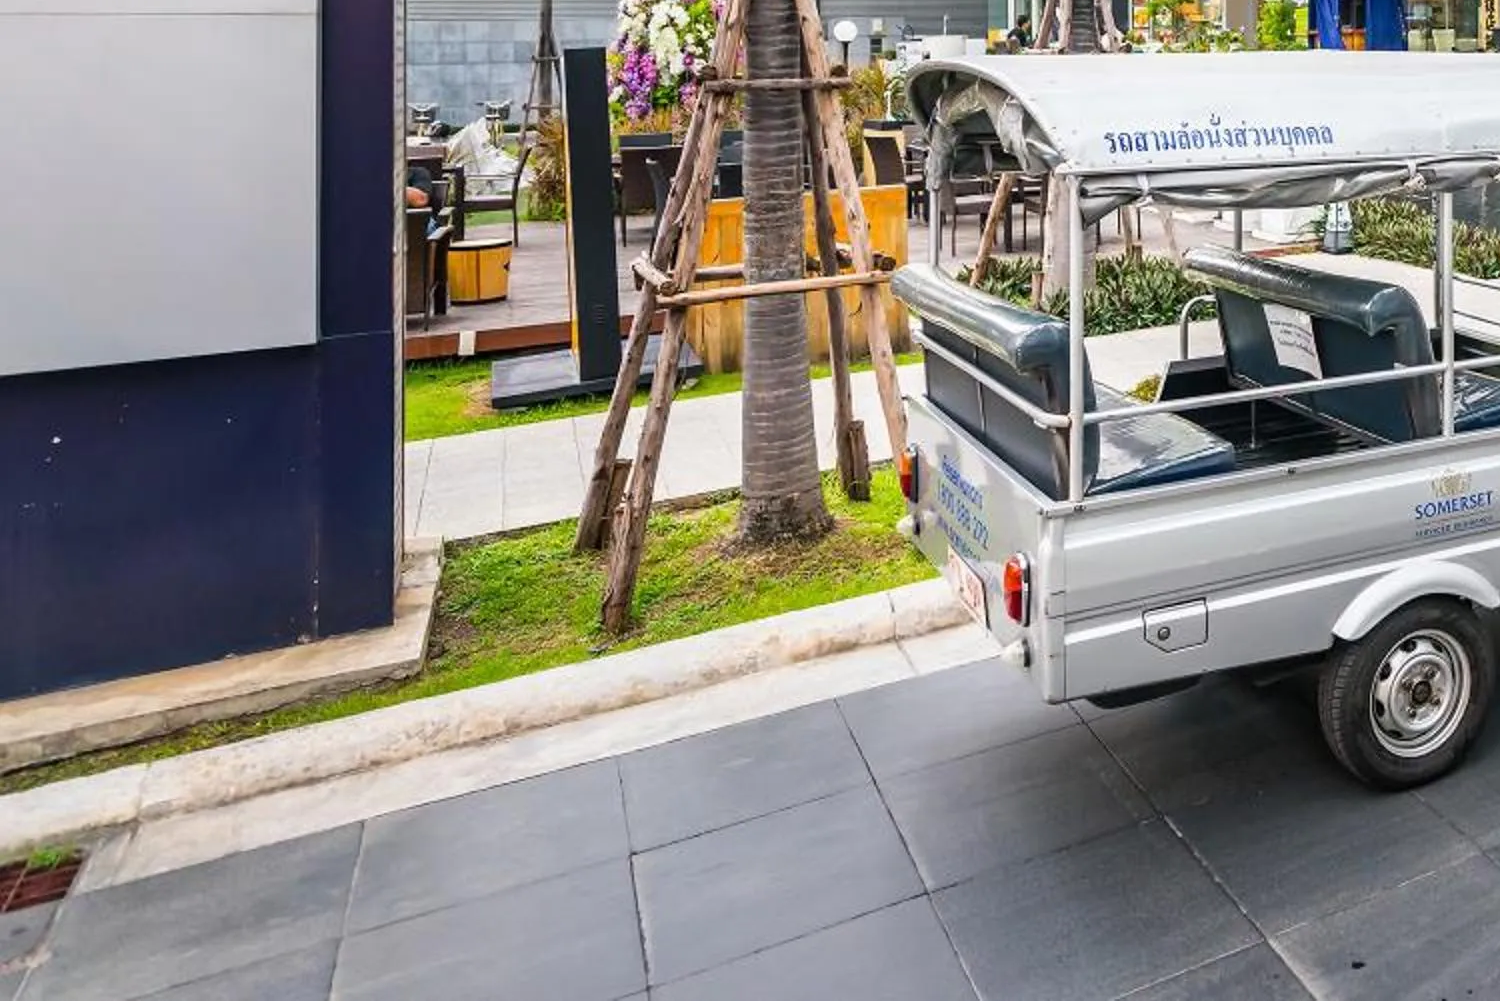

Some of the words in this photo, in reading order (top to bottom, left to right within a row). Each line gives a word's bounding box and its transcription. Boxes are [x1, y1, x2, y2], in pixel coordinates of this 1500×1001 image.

[1104, 112, 1334, 158] รถสามล้อนั่งส่วนบุคคล
[1415, 490, 1493, 520] SOMERSET
